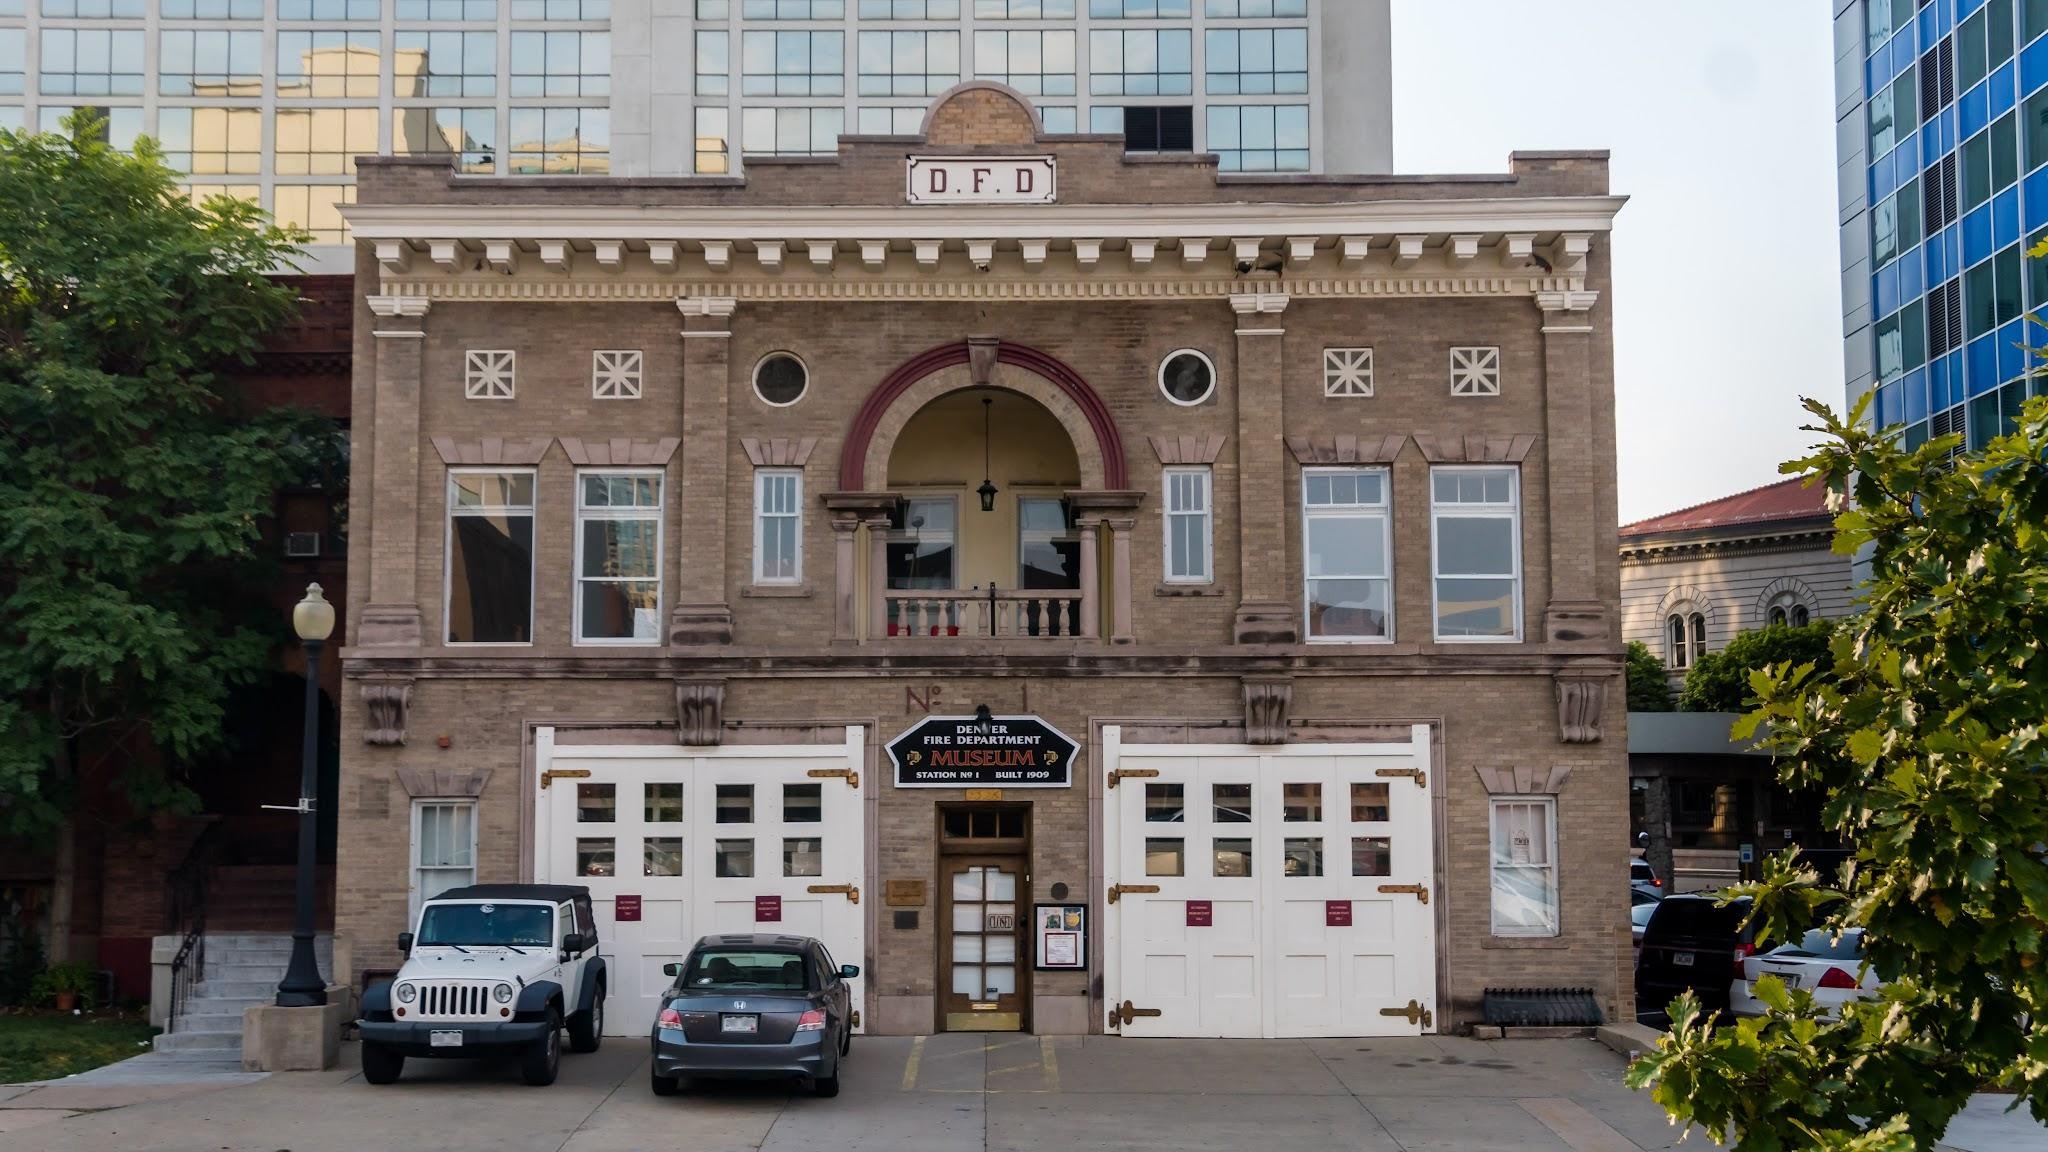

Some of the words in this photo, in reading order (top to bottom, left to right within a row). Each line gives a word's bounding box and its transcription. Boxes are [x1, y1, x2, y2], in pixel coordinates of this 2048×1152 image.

[956, 725, 1009, 734] DENER
[923, 735, 952, 745] FIRE
[956, 735, 1041, 745] DEPARTMENT
[930, 750, 1036, 767] MUSEUM
[916, 771, 957, 779] STATION
[995, 771, 1023, 779] BUILT
[1026, 771, 1050, 779] 1909
